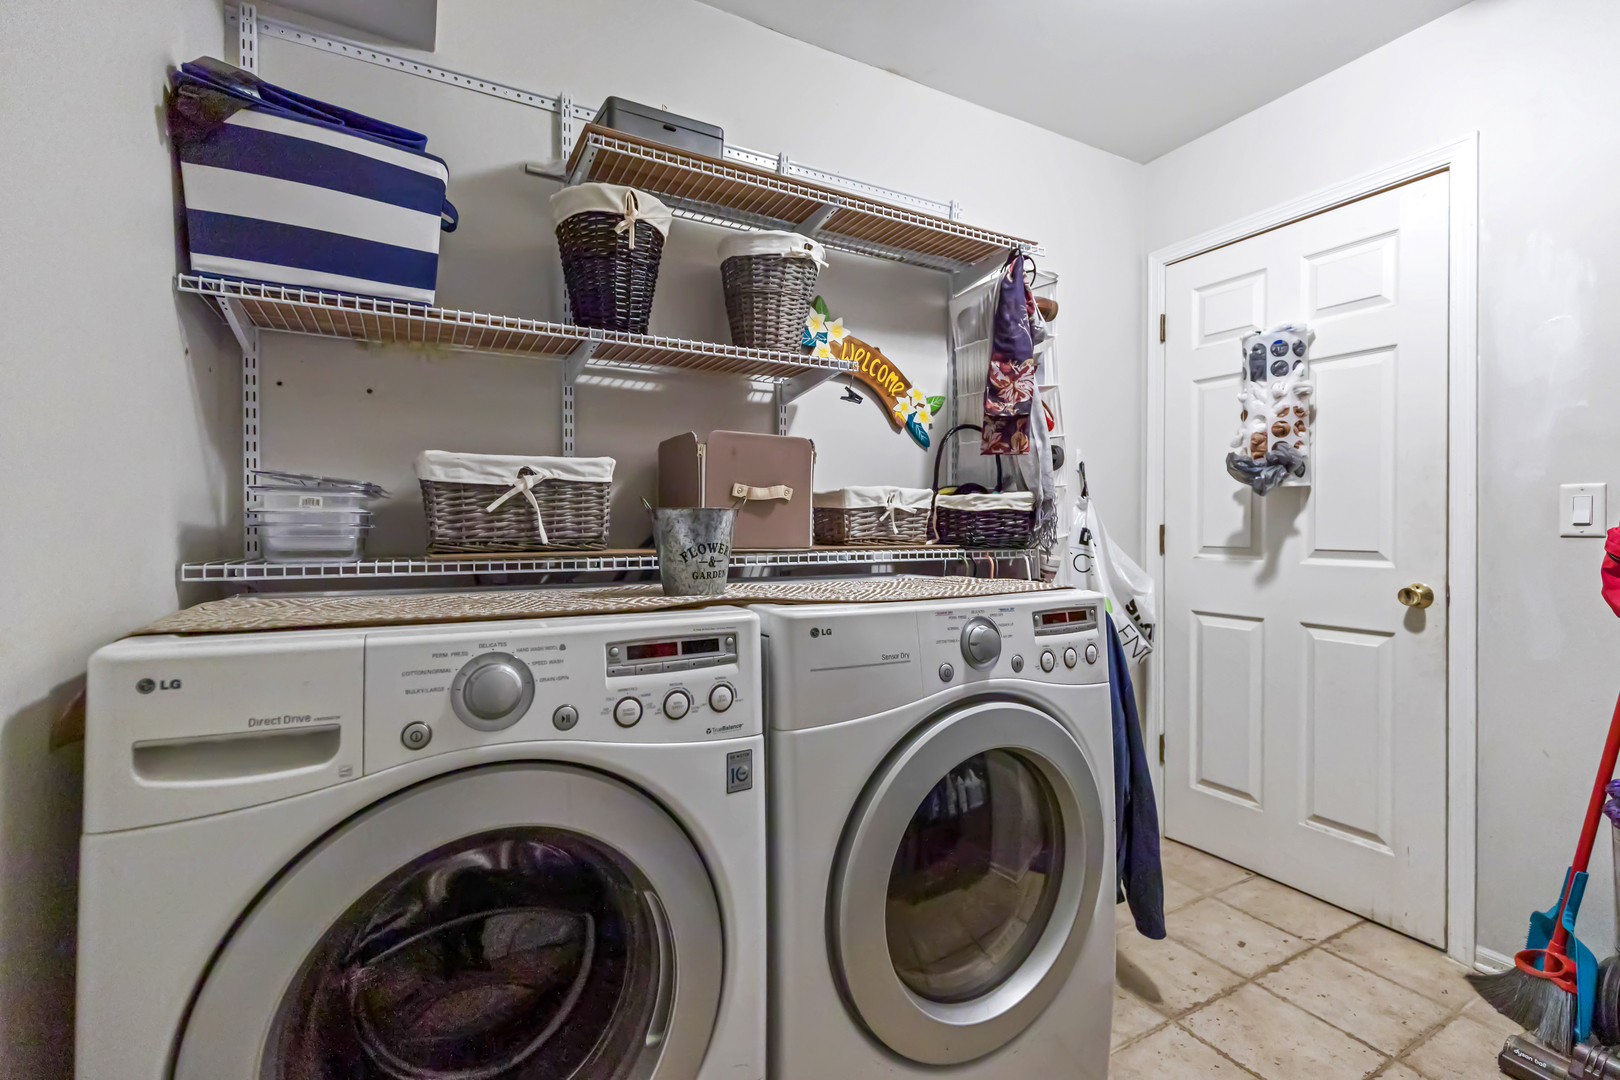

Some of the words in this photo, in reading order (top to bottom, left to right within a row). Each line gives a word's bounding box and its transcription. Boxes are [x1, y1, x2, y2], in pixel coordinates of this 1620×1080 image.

[708, 556, 716, 568] &
[821, 628, 833, 636] LG
[478, 641, 508, 649] DELICATES
[900, 652, 911, 660] Dry
[159, 679, 182, 691] LG
[247, 717, 282, 728] Direct
[283, 714, 312, 725] Drive
[1513, 1049, 1533, 1062] dyson
[1534, 1058, 1547, 1069] ball
